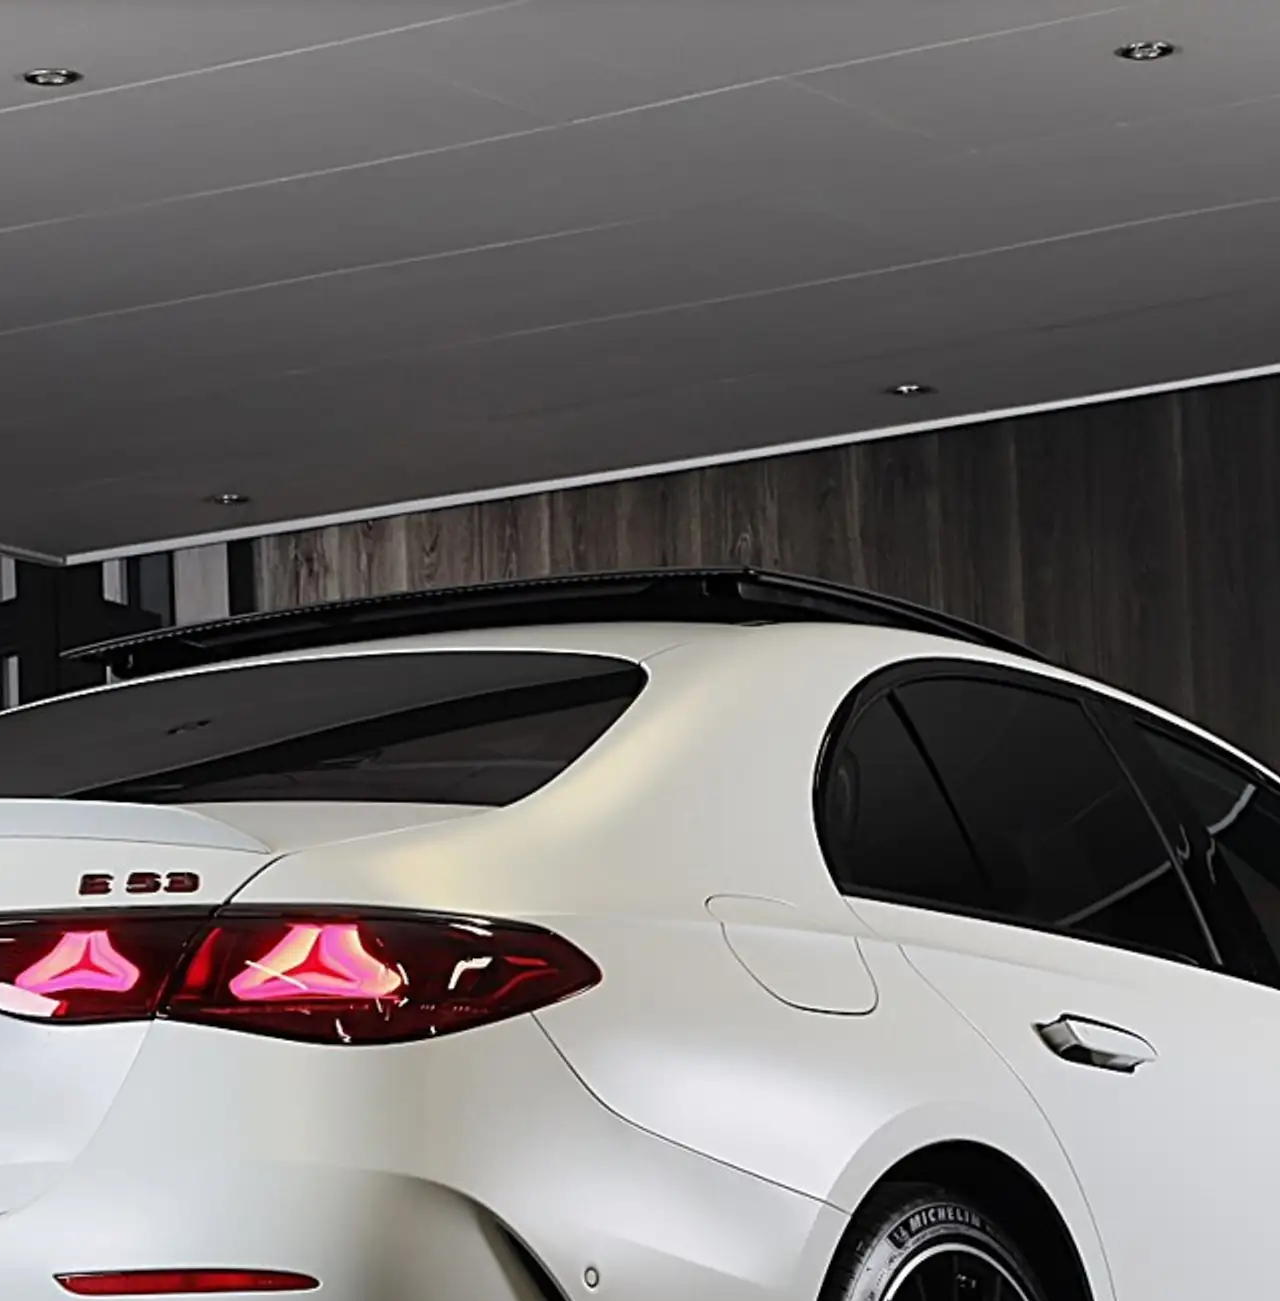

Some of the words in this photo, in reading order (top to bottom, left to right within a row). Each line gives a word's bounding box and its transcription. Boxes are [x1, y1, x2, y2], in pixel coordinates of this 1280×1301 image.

[78, 873, 115, 896] E
[124, 871, 200, 894] 53
[909, 1206, 981, 1232] MICHELIN
